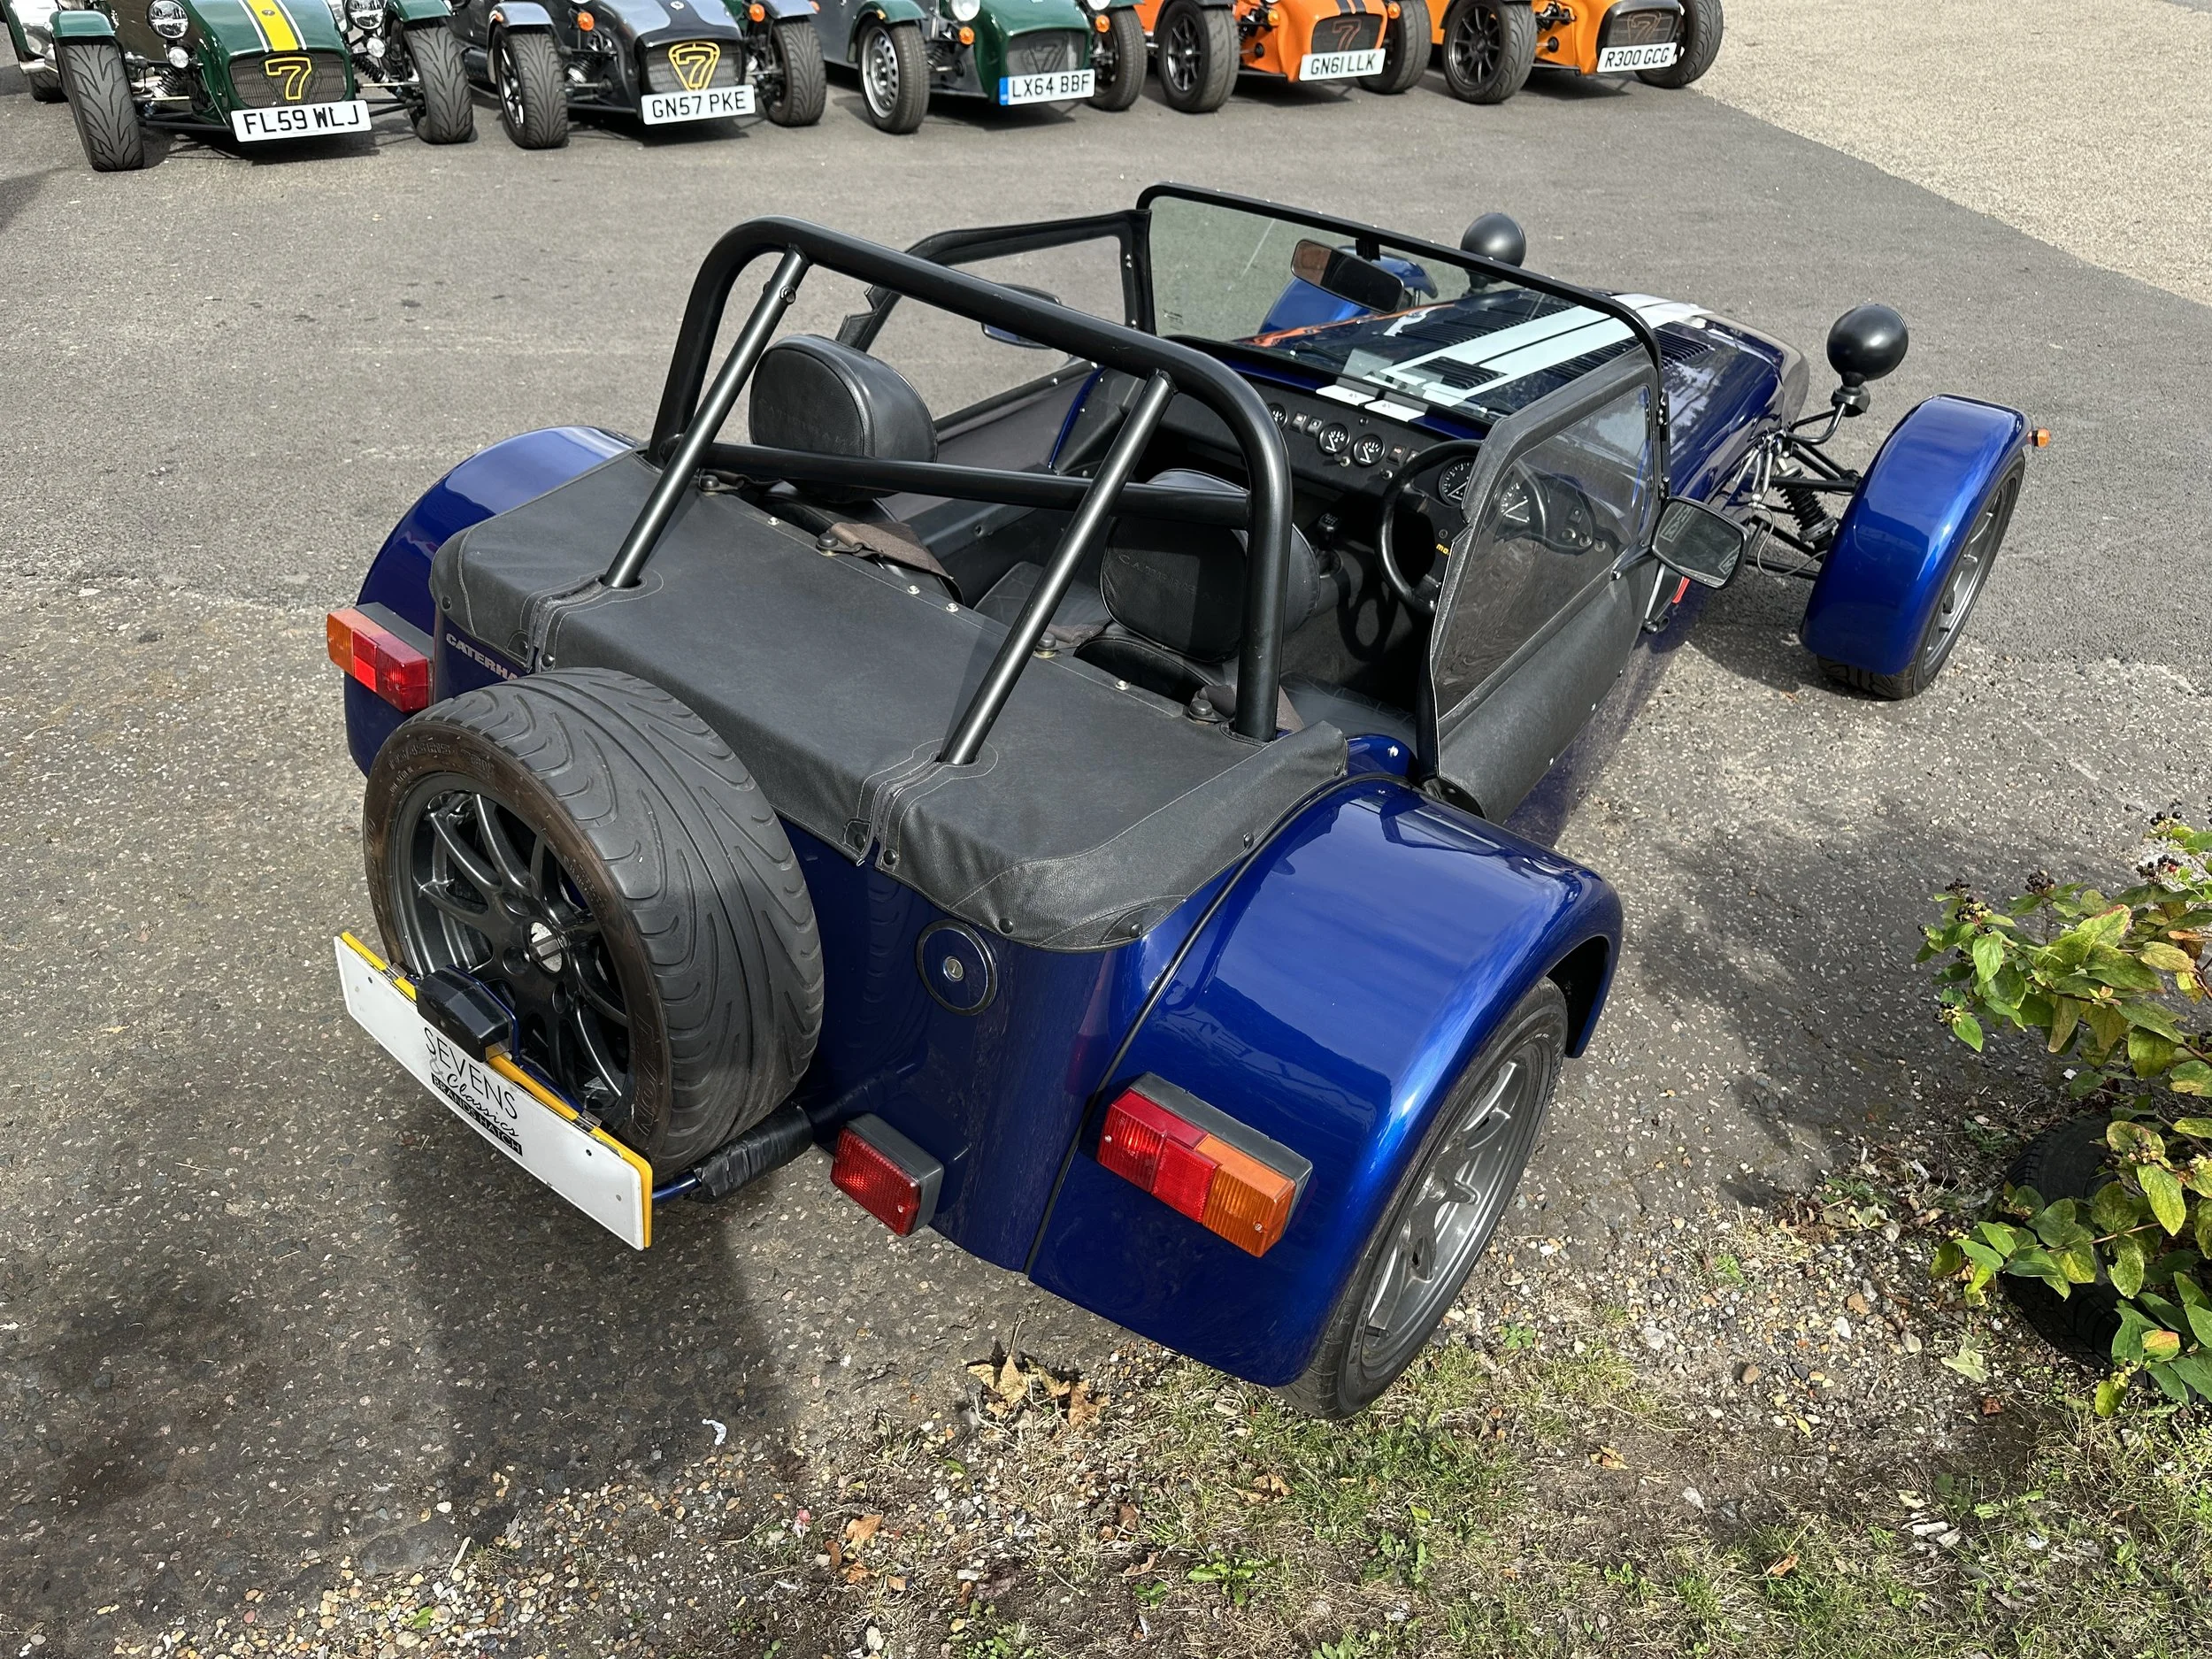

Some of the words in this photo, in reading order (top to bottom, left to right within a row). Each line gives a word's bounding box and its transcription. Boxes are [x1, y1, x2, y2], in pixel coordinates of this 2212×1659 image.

[265, 57, 312, 100] 7
[675, 46, 714, 88] 7
[1310, 57, 1345, 75] GN61
[1347, 53, 1376, 73] LLK
[1605, 50, 1641, 68] R300
[1644, 47, 1670, 65] GCG
[652, 96, 702, 119] GN57
[709, 90, 746, 113] PKE
[1011, 76, 1054, 98] LX64
[1060, 73, 1091, 94] BBF
[242, 110, 309, 134] FL59
[312, 104, 360, 128] WLJ
[446, 633, 518, 680] CATERHA
[424, 1027, 518, 1119] SEVENS
[433, 1077, 477, 1119] BRANDS
[480, 1117, 521, 1154] HATCH
[447, 1073, 519, 1137] Classics
